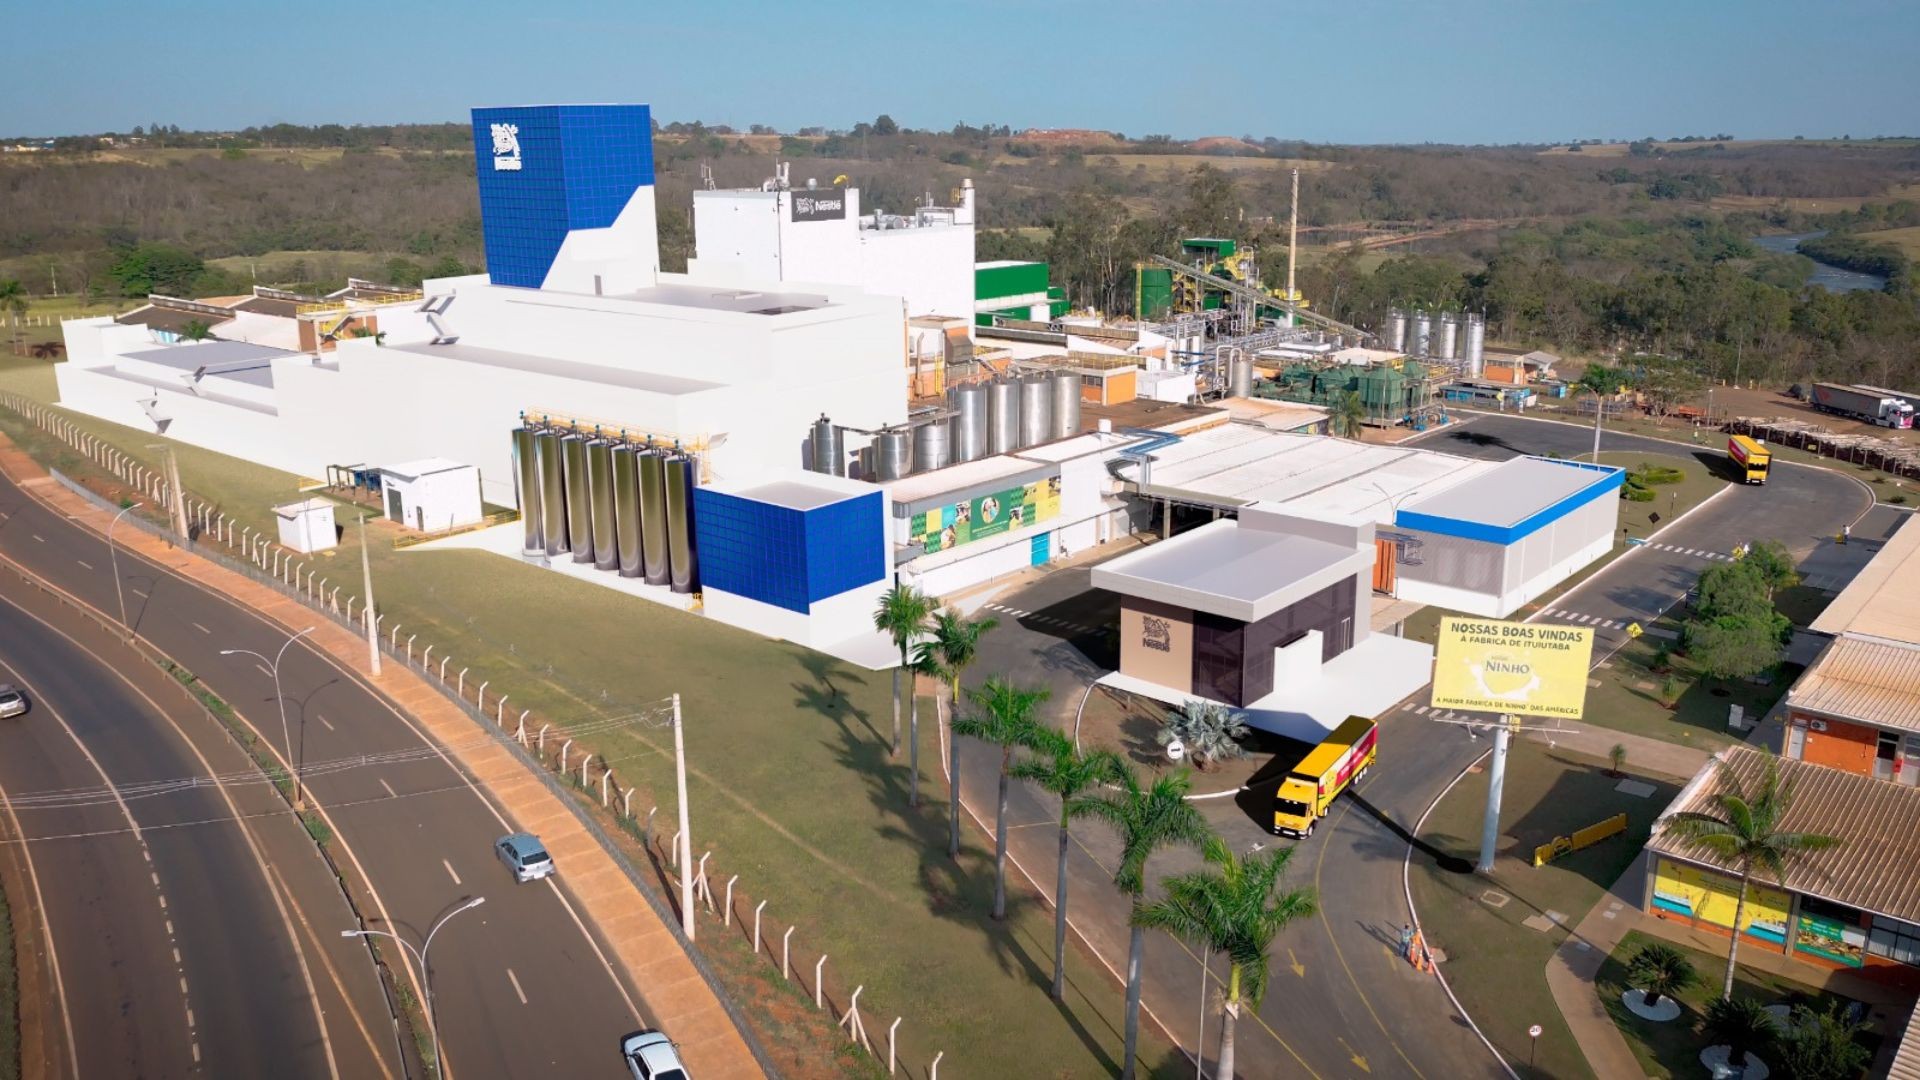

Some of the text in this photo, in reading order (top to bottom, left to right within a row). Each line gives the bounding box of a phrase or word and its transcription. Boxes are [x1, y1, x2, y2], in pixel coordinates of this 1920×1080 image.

[1451, 622, 1583, 643] NOSSAS BOAS VINDAS
[1509, 639, 1521, 647] DE
[1523, 641, 1570, 651] ITUIUTABA
[1486, 660, 1530, 674] NINHO
